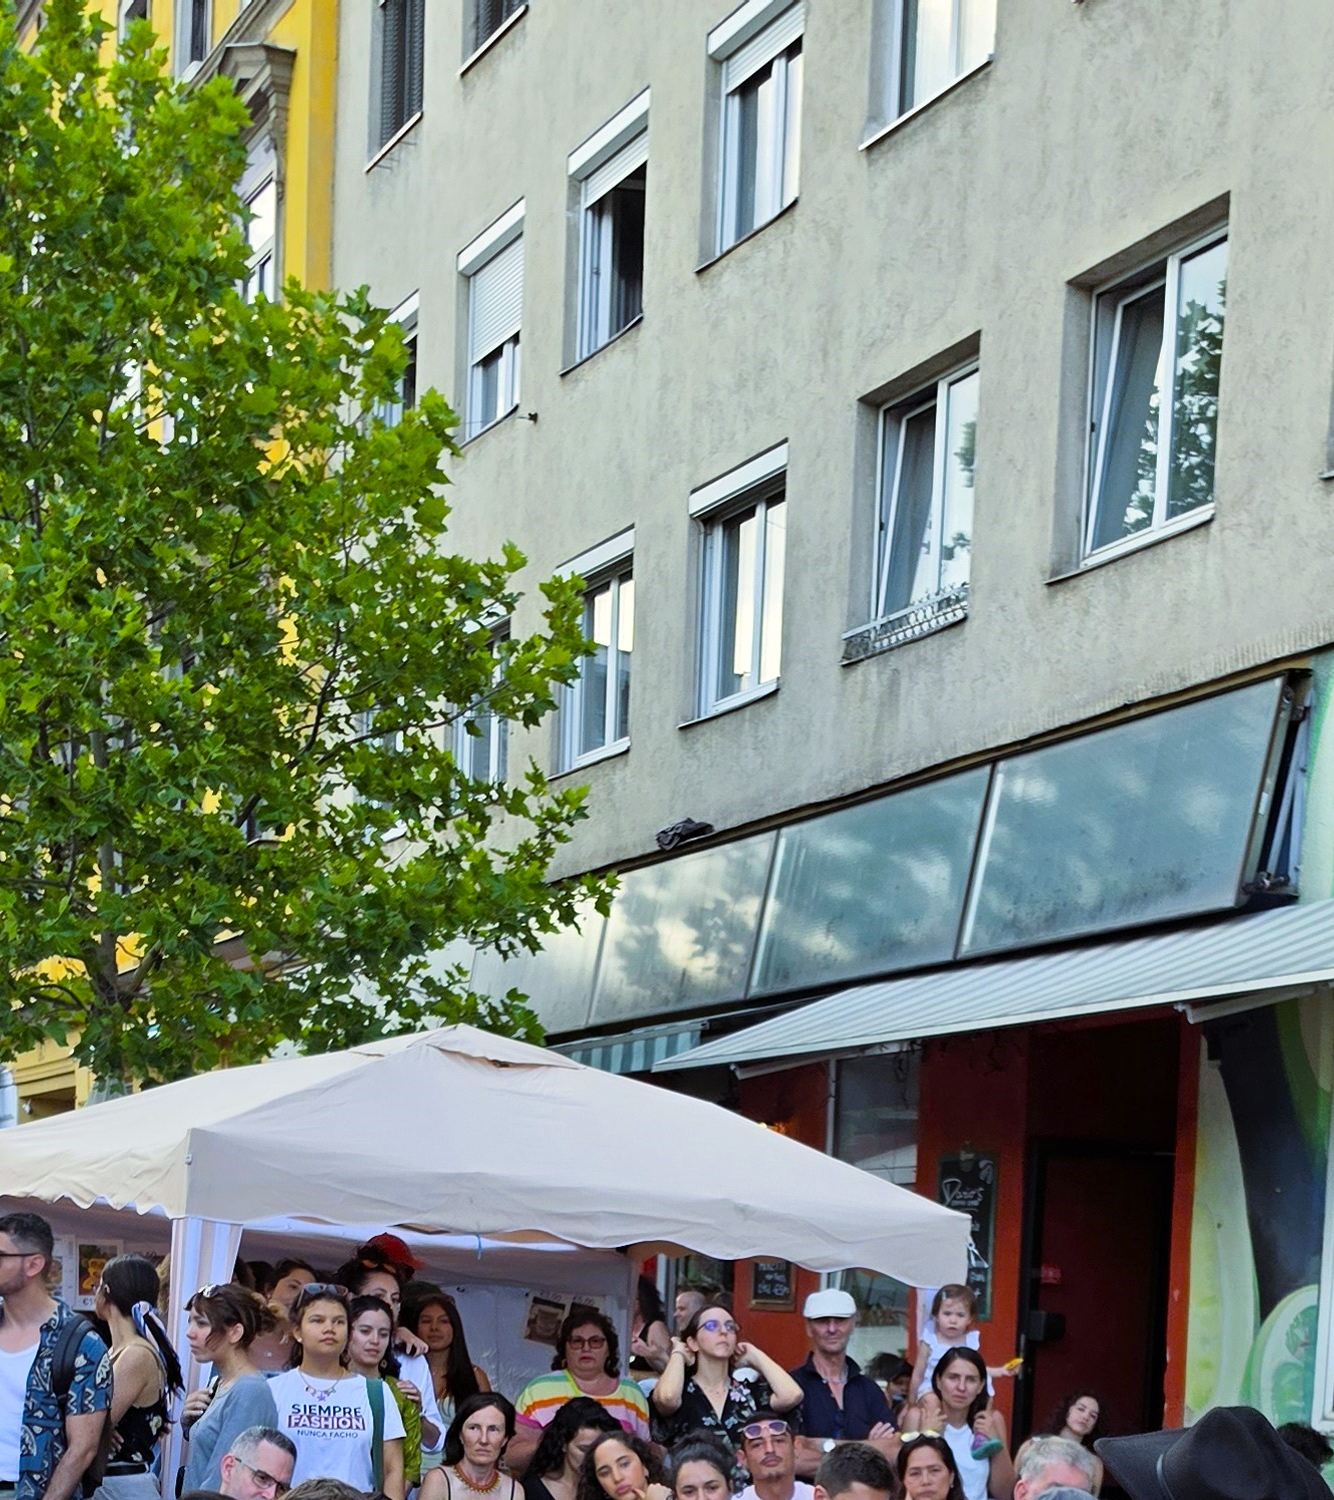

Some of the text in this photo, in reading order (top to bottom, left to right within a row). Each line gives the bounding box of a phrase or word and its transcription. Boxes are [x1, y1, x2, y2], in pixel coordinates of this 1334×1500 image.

[291, 1403, 363, 1417] SIEMPRE
[290, 1415, 365, 1430] FASHION
[297, 1430, 359, 1439] NUNCA FACHO
